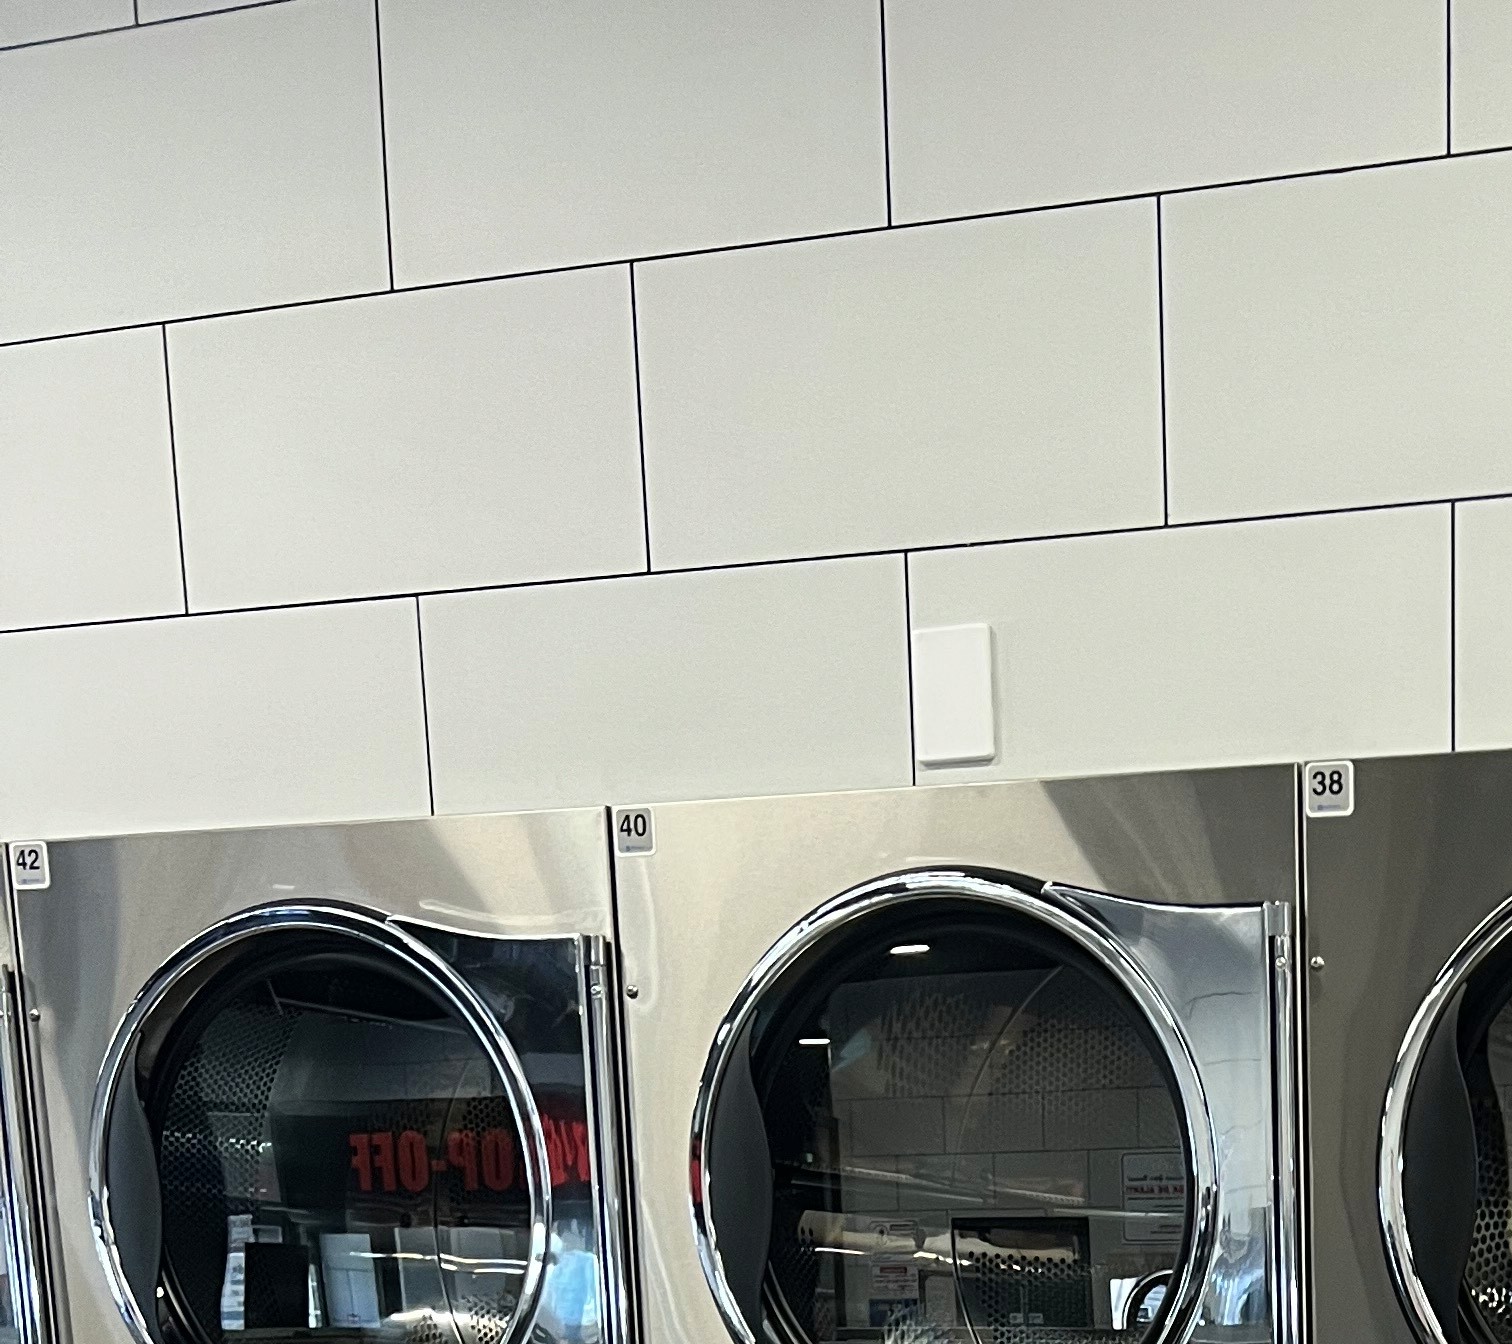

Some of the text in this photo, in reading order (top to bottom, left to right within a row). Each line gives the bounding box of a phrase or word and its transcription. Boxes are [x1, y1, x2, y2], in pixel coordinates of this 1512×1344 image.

[1312, 770, 1344, 796] 38
[620, 813, 647, 837] 40
[16, 849, 41, 870] 42
